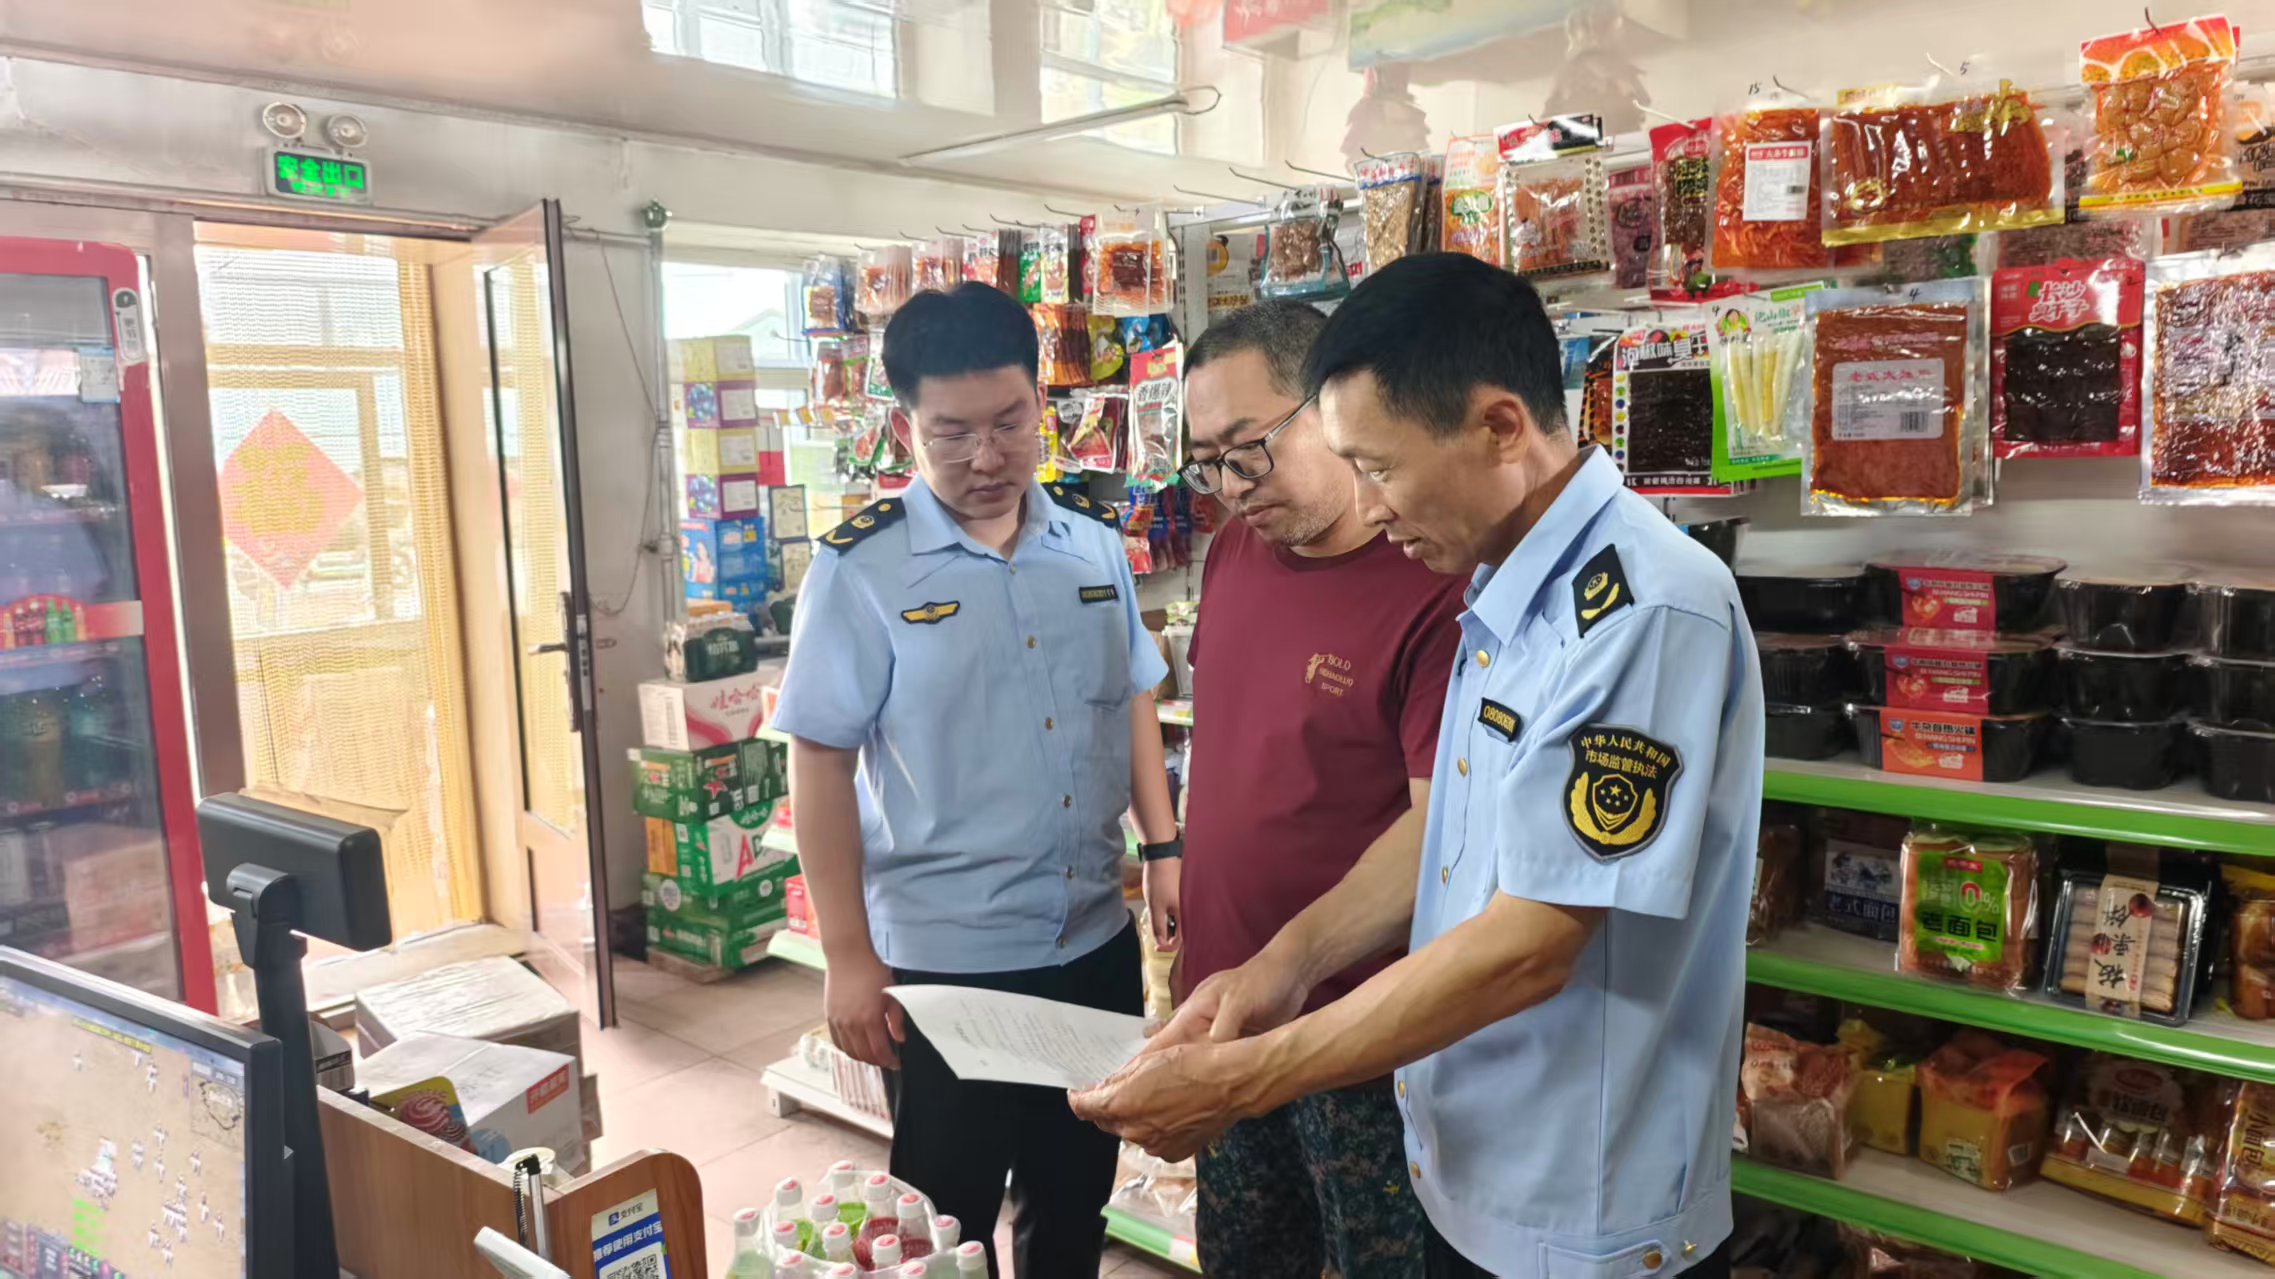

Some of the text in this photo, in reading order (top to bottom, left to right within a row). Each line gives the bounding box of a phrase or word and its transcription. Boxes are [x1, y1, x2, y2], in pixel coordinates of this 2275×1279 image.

[278, 155, 363, 188] 安全出口
[1581, 734, 1671, 769] 中华人民共和国
[1585, 749, 1657, 780] 市场监管执法
